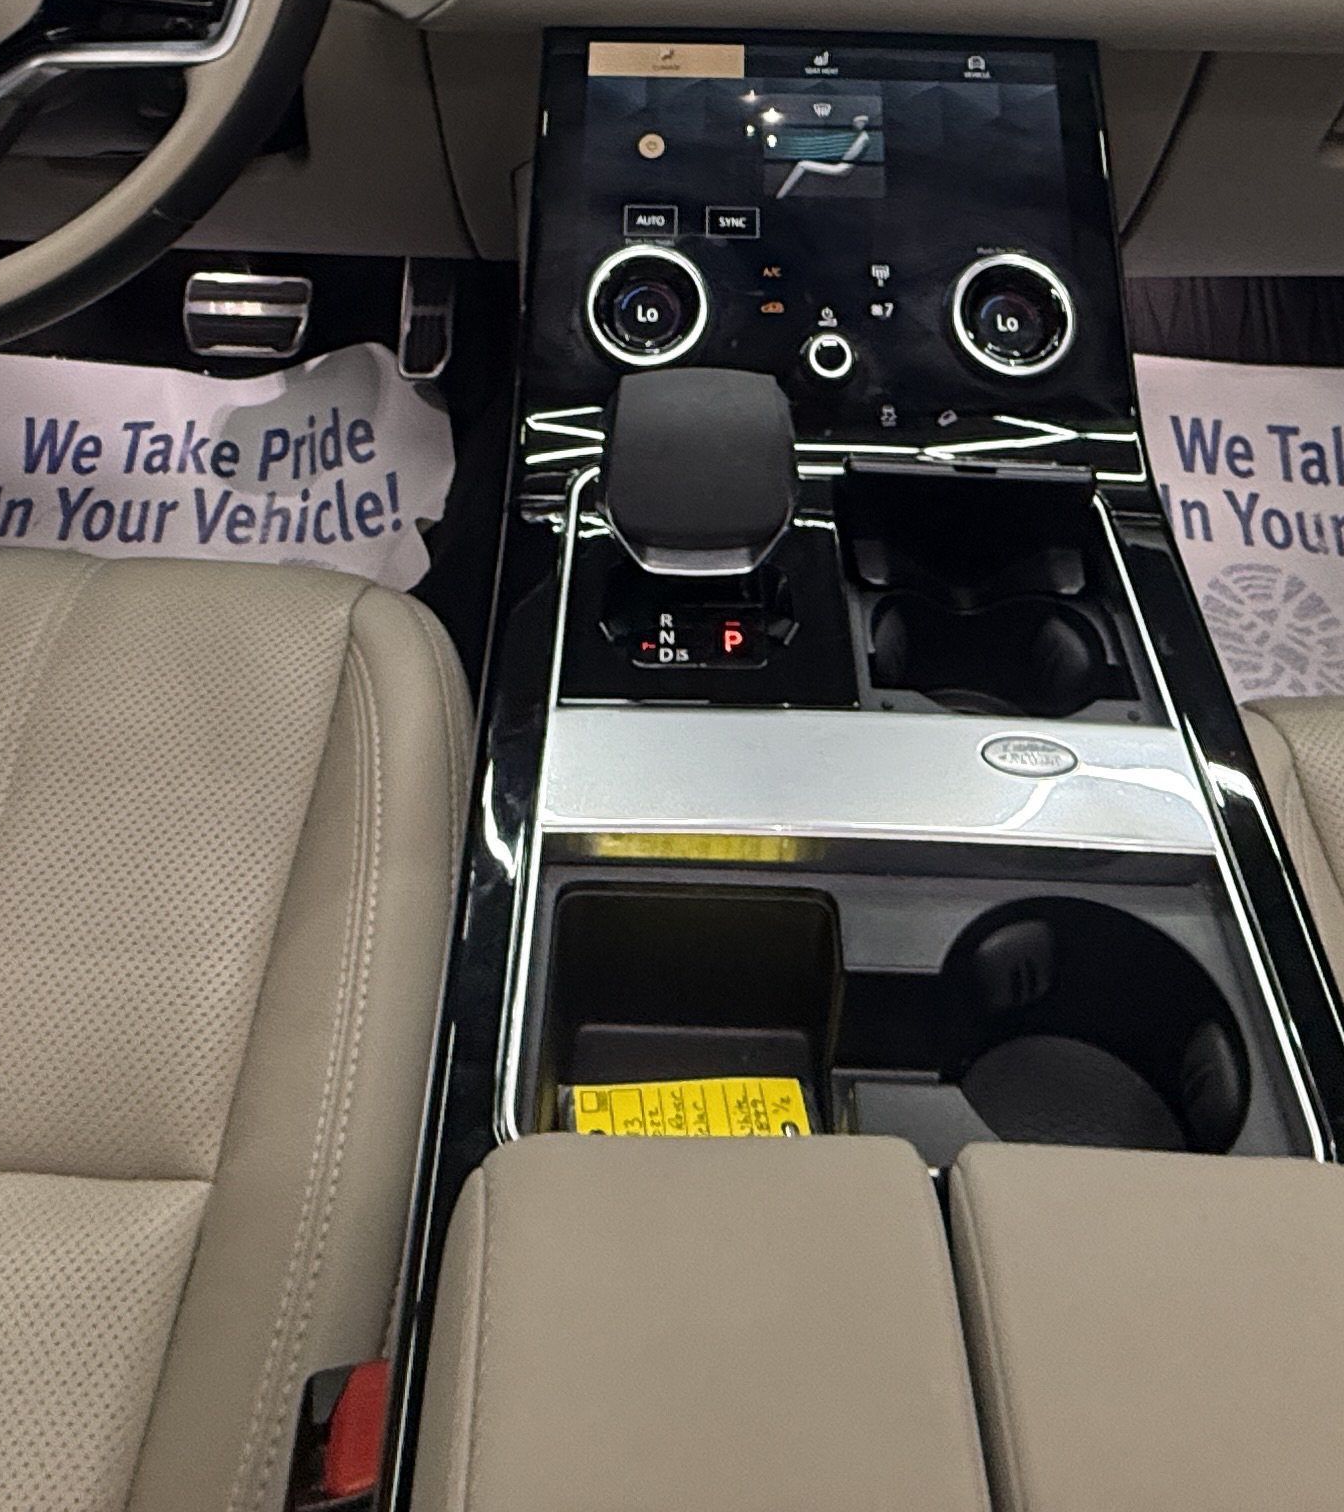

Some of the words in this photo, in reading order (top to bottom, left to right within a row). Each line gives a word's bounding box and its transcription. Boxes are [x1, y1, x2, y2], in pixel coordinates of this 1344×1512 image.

[635, 215, 665, 227] AUTO
[718, 216, 747, 228] SYNC
[763, 266, 781, 277] A/C
[637, 304, 658, 323] Lo
[884, 302, 894, 317] 7
[996, 314, 1018, 332] Lo
[23, 417, 103, 475] We
[121, 420, 241, 478] Take
[257, 407, 378, 482] Pride
[1169, 415, 1256, 479] We
[55, 487, 180, 544] Your
[193, 472, 404, 545] Vehicle!
[1159, 483, 1214, 543] In
[660, 613, 673, 628] R
[659, 629, 675, 645] N
[724, 630, 743, 653] P
